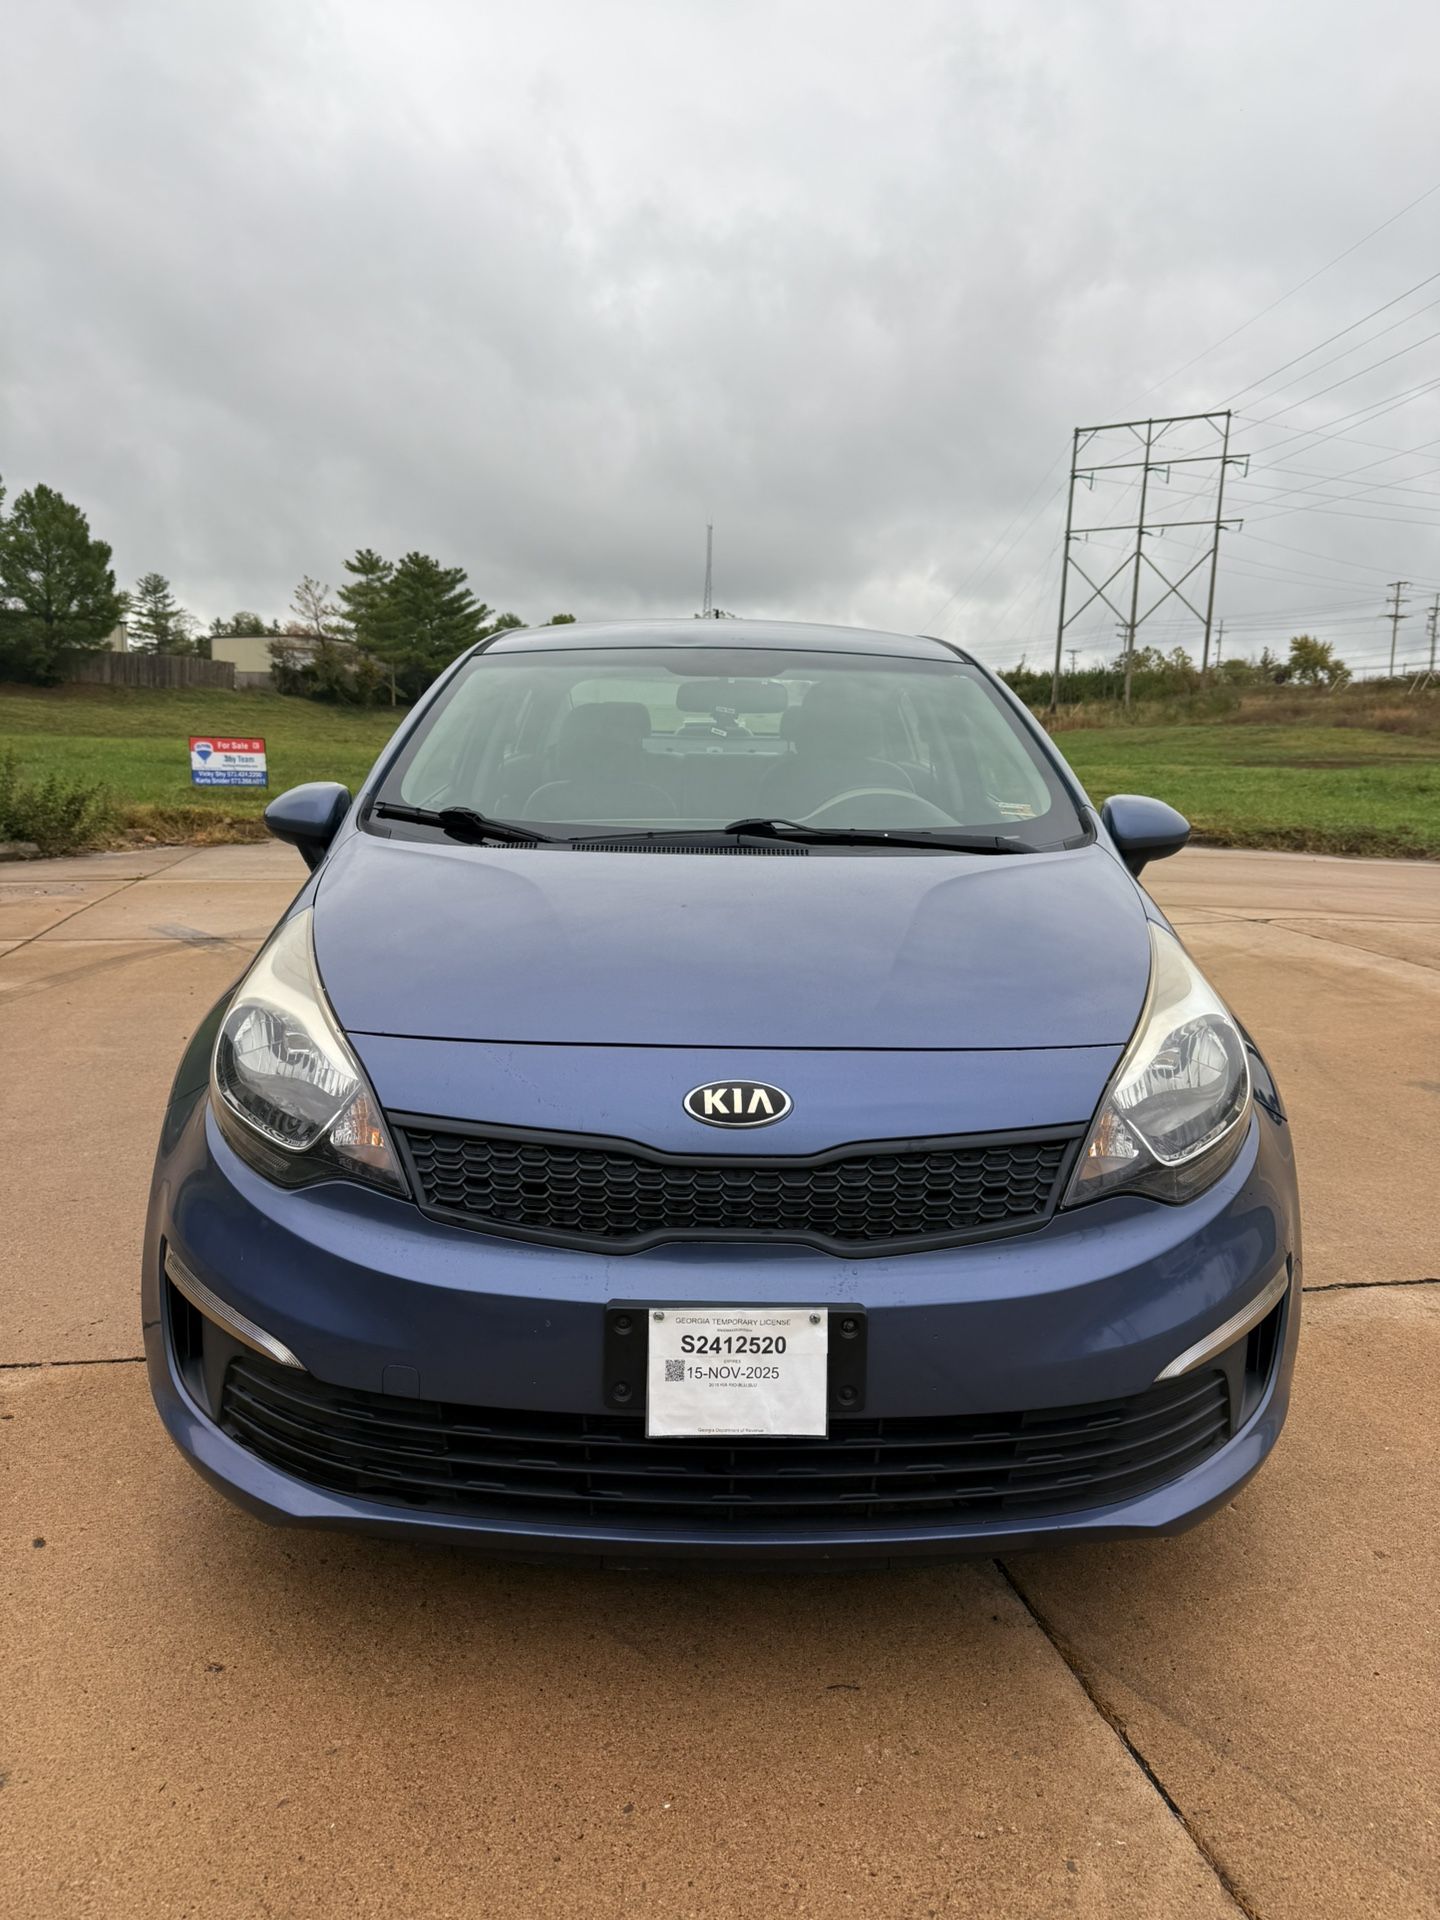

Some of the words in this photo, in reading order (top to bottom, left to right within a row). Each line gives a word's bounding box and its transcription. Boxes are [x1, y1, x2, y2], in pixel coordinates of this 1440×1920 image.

[217, 741, 230, 750] For
[231, 741, 249, 750] Sale
[238, 755, 255, 763] Team
[702, 1088, 775, 1115] KIA
[675, 1316, 710, 1325] GEORGIA
[712, 1317, 758, 1326] TEMPORARY
[760, 1318, 792, 1326] LICENSE
[681, 1335, 787, 1354] S2412520
[687, 1366, 780, 1380] 15-NOV-2025
